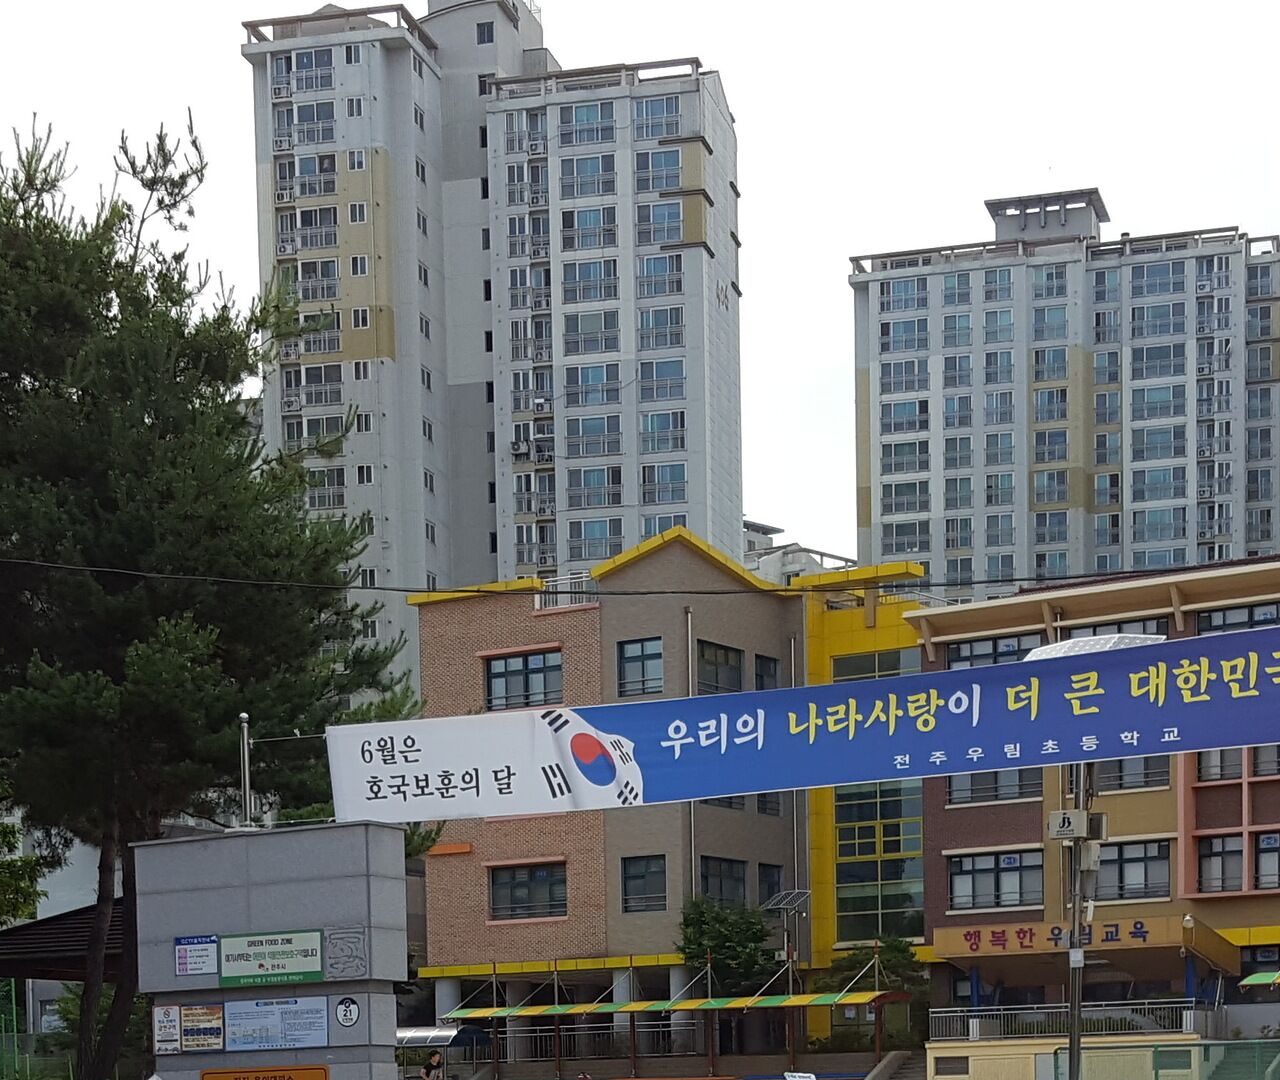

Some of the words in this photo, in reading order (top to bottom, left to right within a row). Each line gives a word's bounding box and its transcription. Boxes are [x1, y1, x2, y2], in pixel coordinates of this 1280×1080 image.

[660, 709, 765, 761] 우리의
[787, 683, 981, 744] 나라사랑이
[1006, 676, 1039, 719] 더
[1064, 671, 1105, 716] 큰
[359, 735, 423, 766] 6월은
[894, 726, 1182, 771] 전주우림초등학교
[365, 771, 482, 804] 호국보훈의
[491, 766, 517, 797] 달
[247, 940, 264, 948] GREEN
[265, 939, 279, 947] FOOD
[962, 927, 1037, 952] 행복한
[343, 1009, 352, 1017] 21
